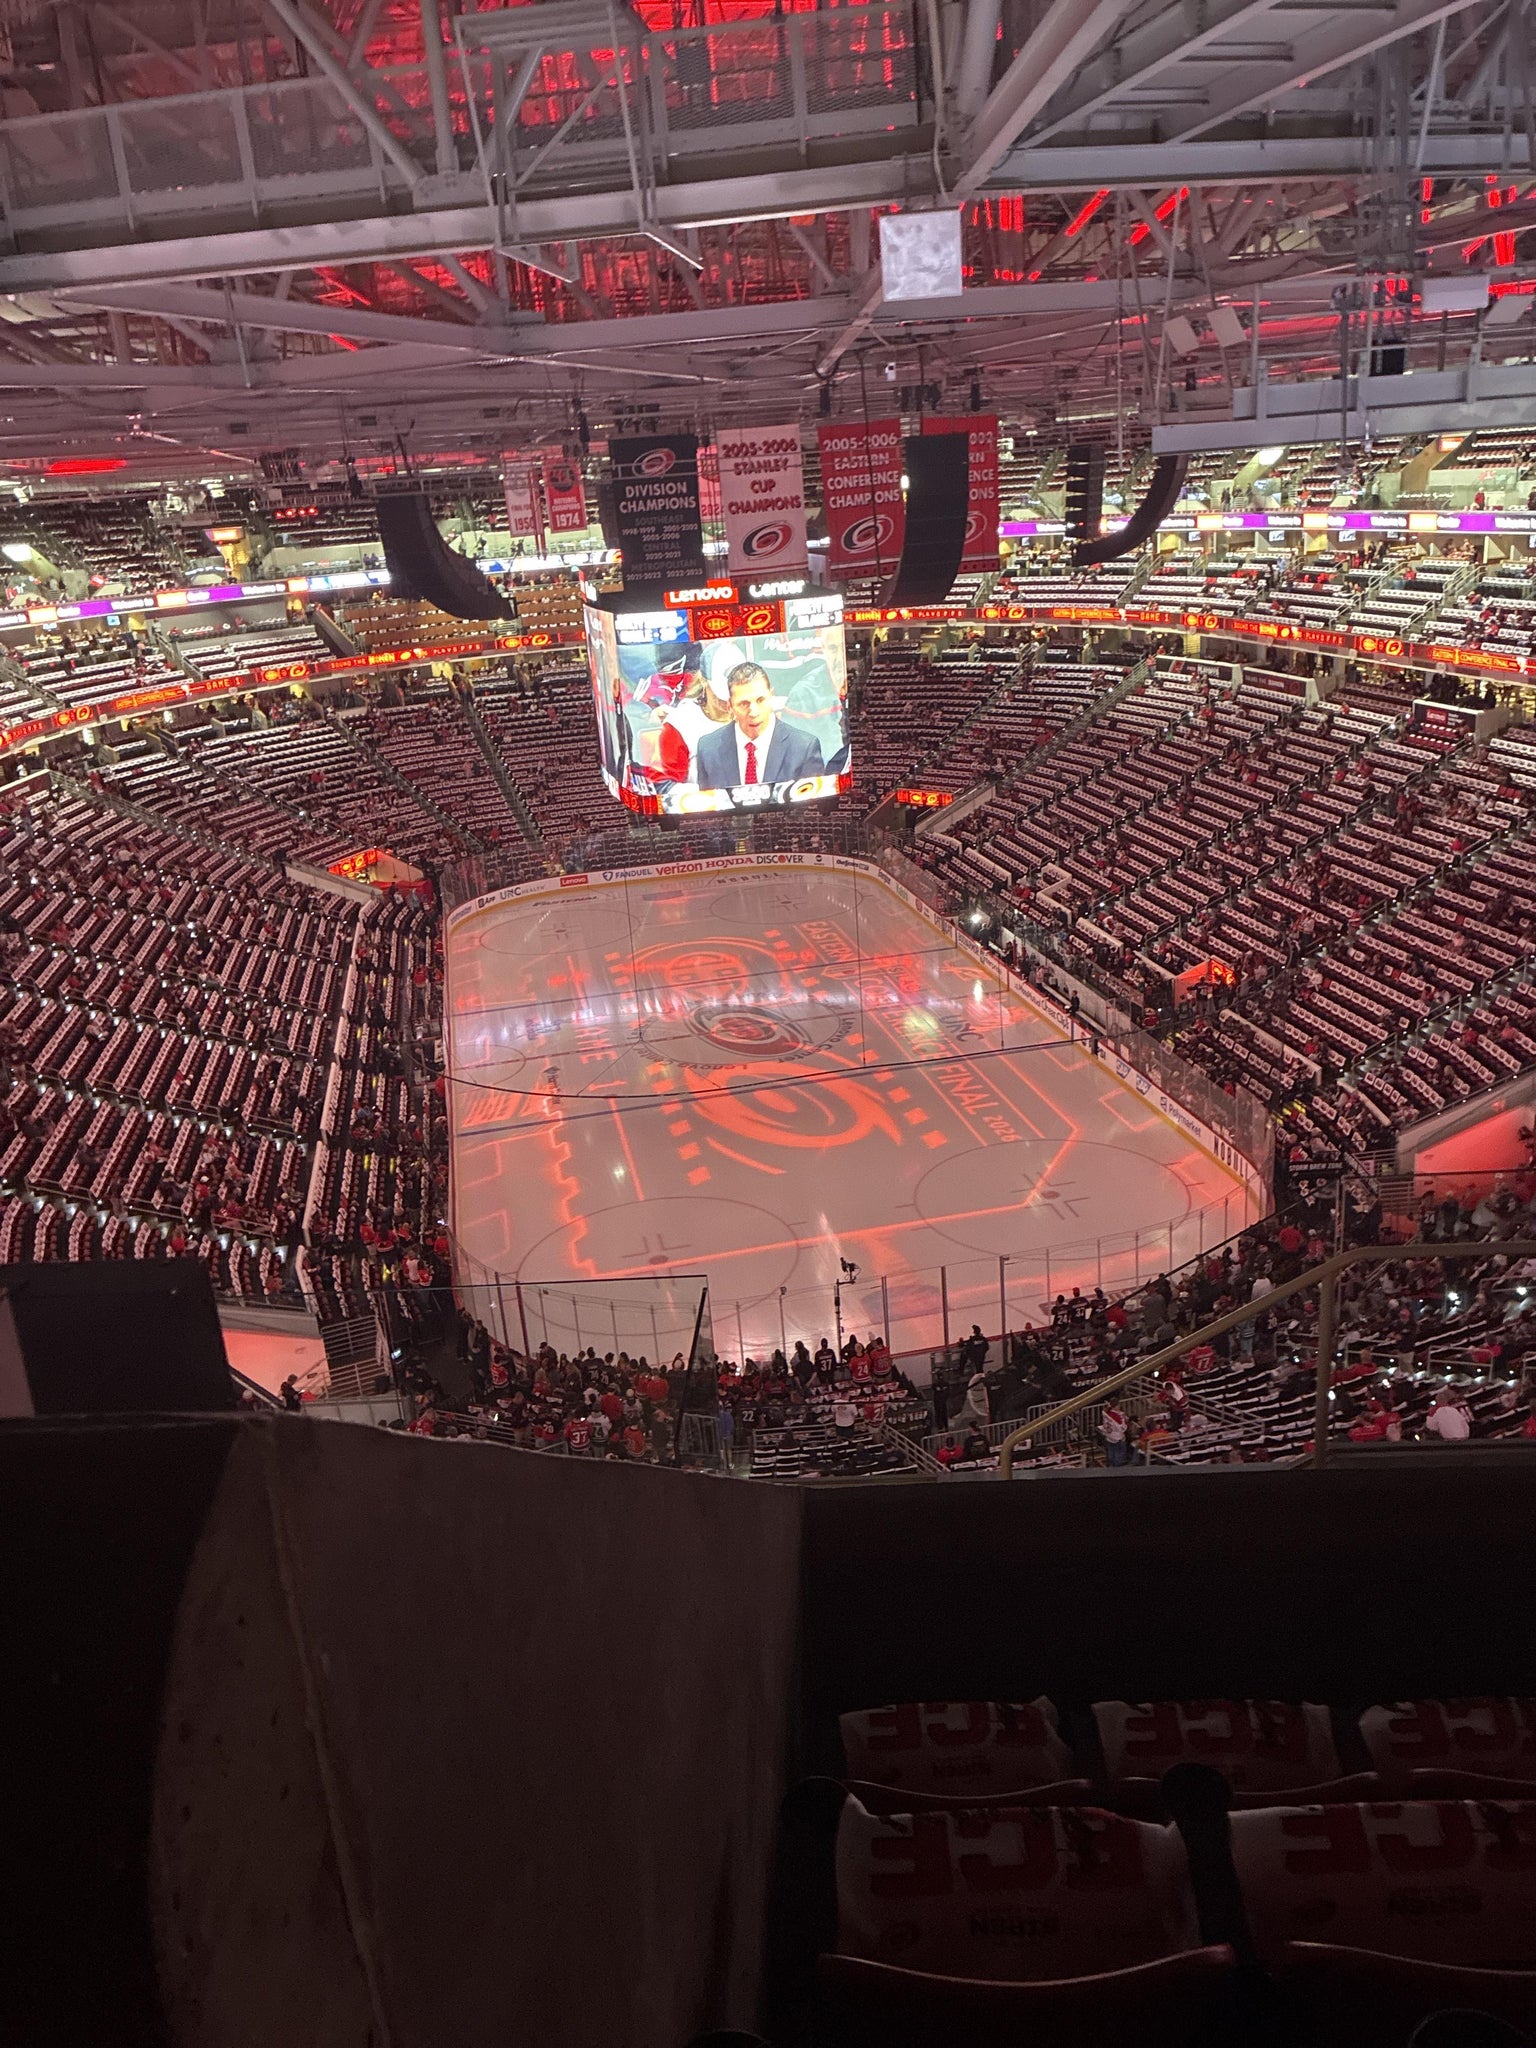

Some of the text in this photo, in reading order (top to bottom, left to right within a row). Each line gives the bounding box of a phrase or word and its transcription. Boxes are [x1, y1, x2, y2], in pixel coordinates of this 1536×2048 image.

[722, 438, 798, 458] 2005-2006
[734, 457, 789, 476] STANLEY
[750, 479, 776, 494] CUP
[827, 471, 899, 490] CONFERENCE
[625, 482, 687, 498] DIVISION
[619, 496, 696, 513] CHAMPIONS
[728, 495, 802, 515] CHAMPIONS
[829, 489, 900, 509] CHAMPONS
[556, 512, 580, 527] 1974
[1140, 613, 1160, 621] GAME
[206, 678, 231, 691] GAME
[706, 857, 754, 869] HONDA
[757, 854, 804, 864] DISCOVER
[615, 868, 653, 879] FANDUEL
[656, 862, 703, 875] verizon
[561, 877, 586, 886] Lenovo
[500, 887, 521, 900] UNC
[802, 920, 857, 963] EASTERN
[931, 1062, 998, 1116] FINAL
[982, 1114, 1024, 1143] 2026
[821, 1359, 832, 1371] 37
[857, 1364, 868, 1376] 24
[572, 1430, 587, 1444] 37
